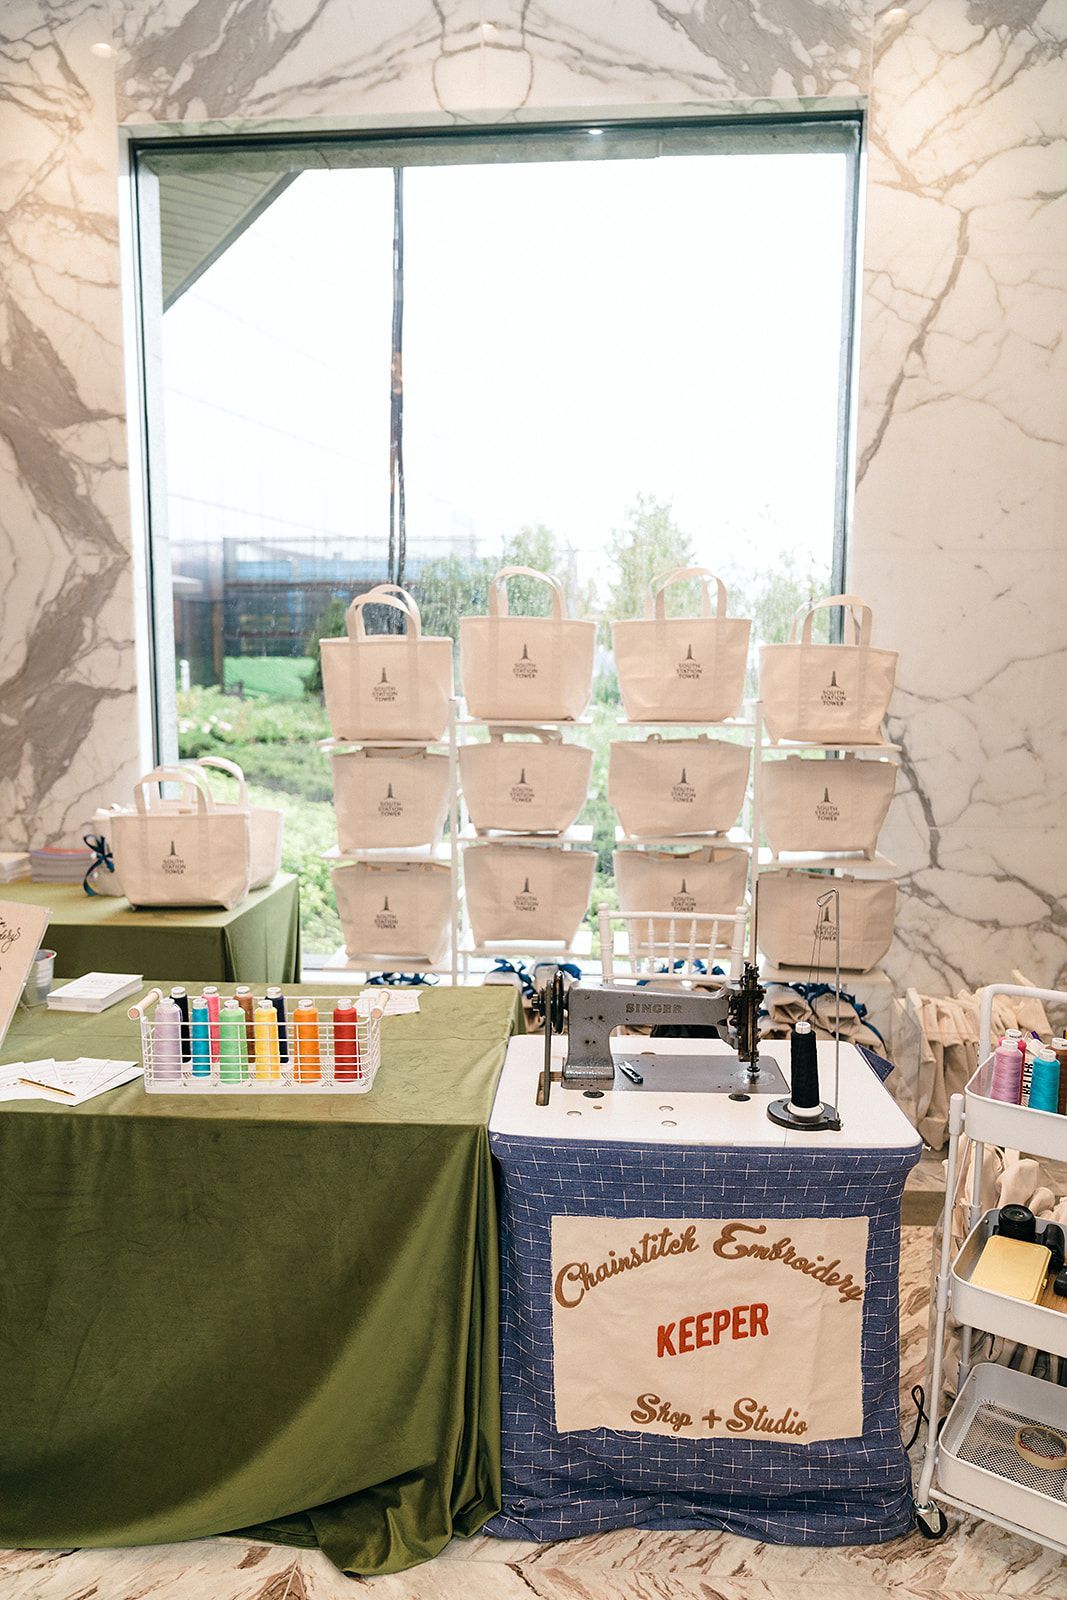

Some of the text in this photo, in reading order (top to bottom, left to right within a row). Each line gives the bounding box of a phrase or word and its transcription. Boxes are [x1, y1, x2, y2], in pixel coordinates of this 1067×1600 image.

[625, 1003, 682, 1014] SINGER
[554, 1223, 863, 1308] Chainstitch Embroidery
[656, 1303, 769, 1358] KEEPER
[630, 1393, 809, 1436] Shop + Studio
